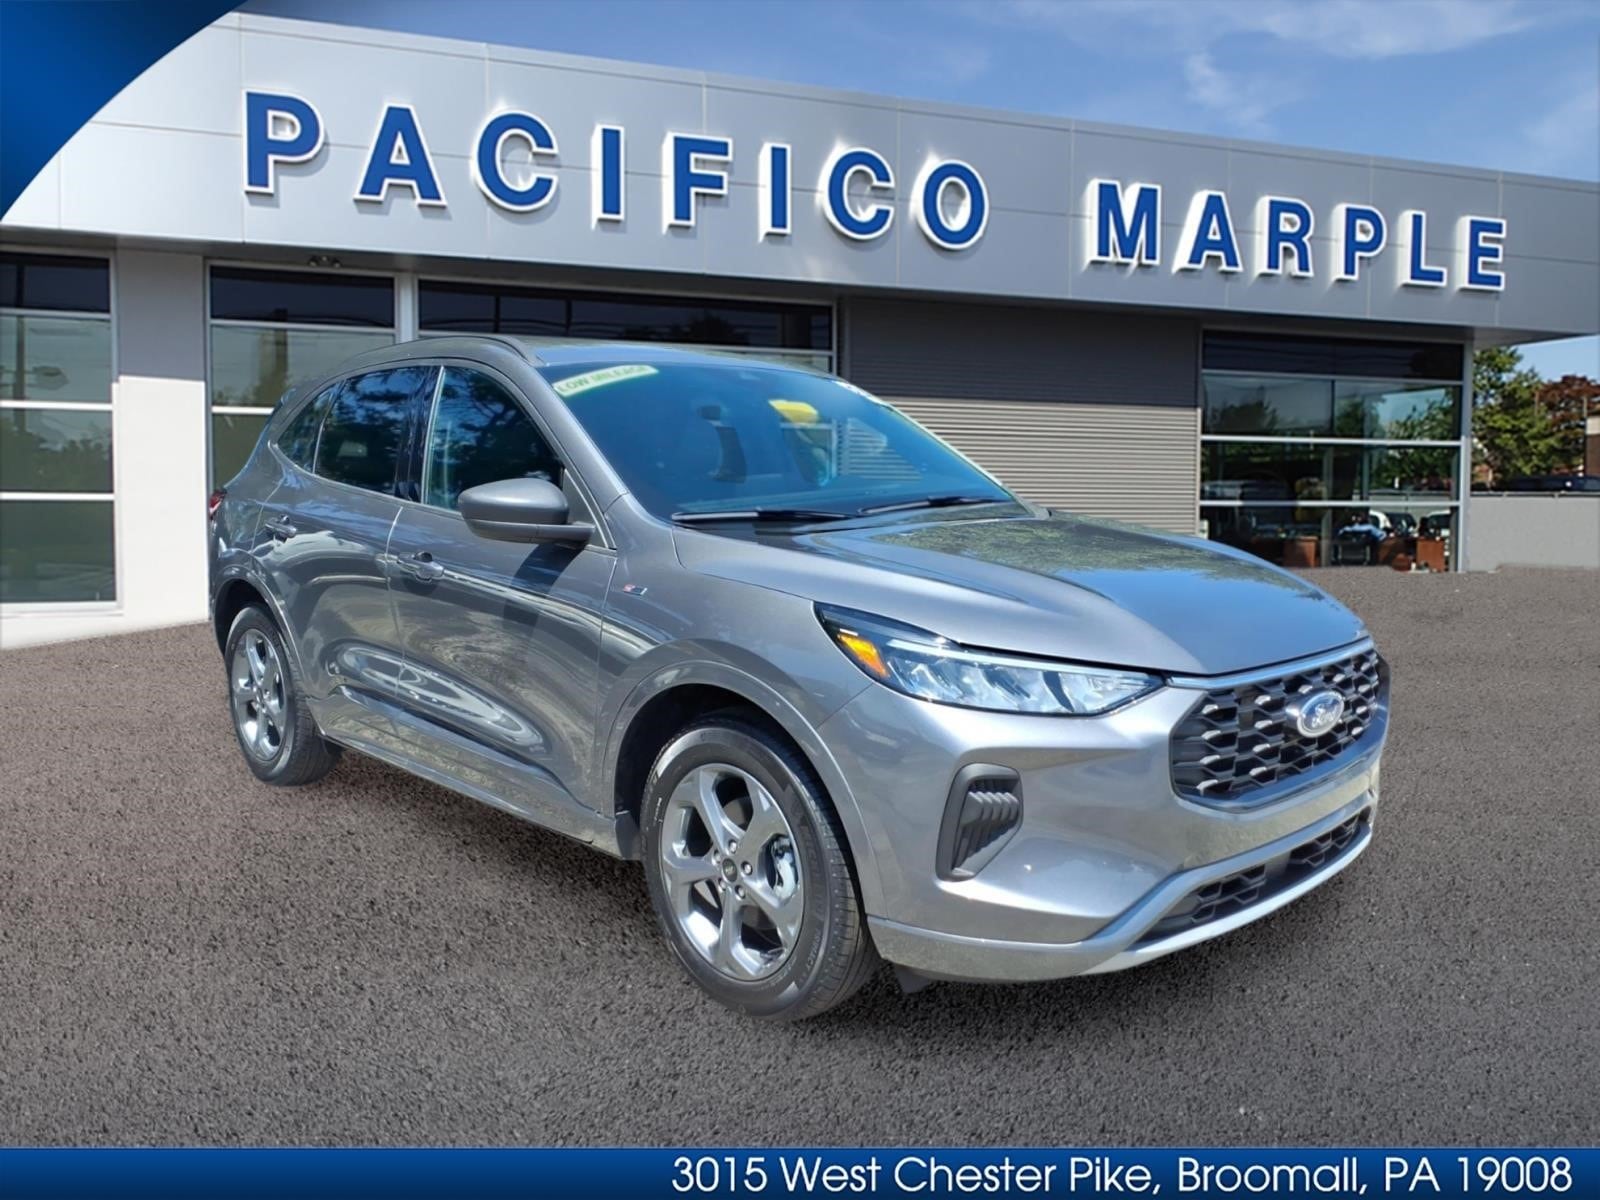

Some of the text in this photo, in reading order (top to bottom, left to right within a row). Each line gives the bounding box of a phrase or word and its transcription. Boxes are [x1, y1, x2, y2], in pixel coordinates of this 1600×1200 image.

[244, 89, 1506, 291] PACIFICO MARPLE
[557, 376, 590, 393] LOW
